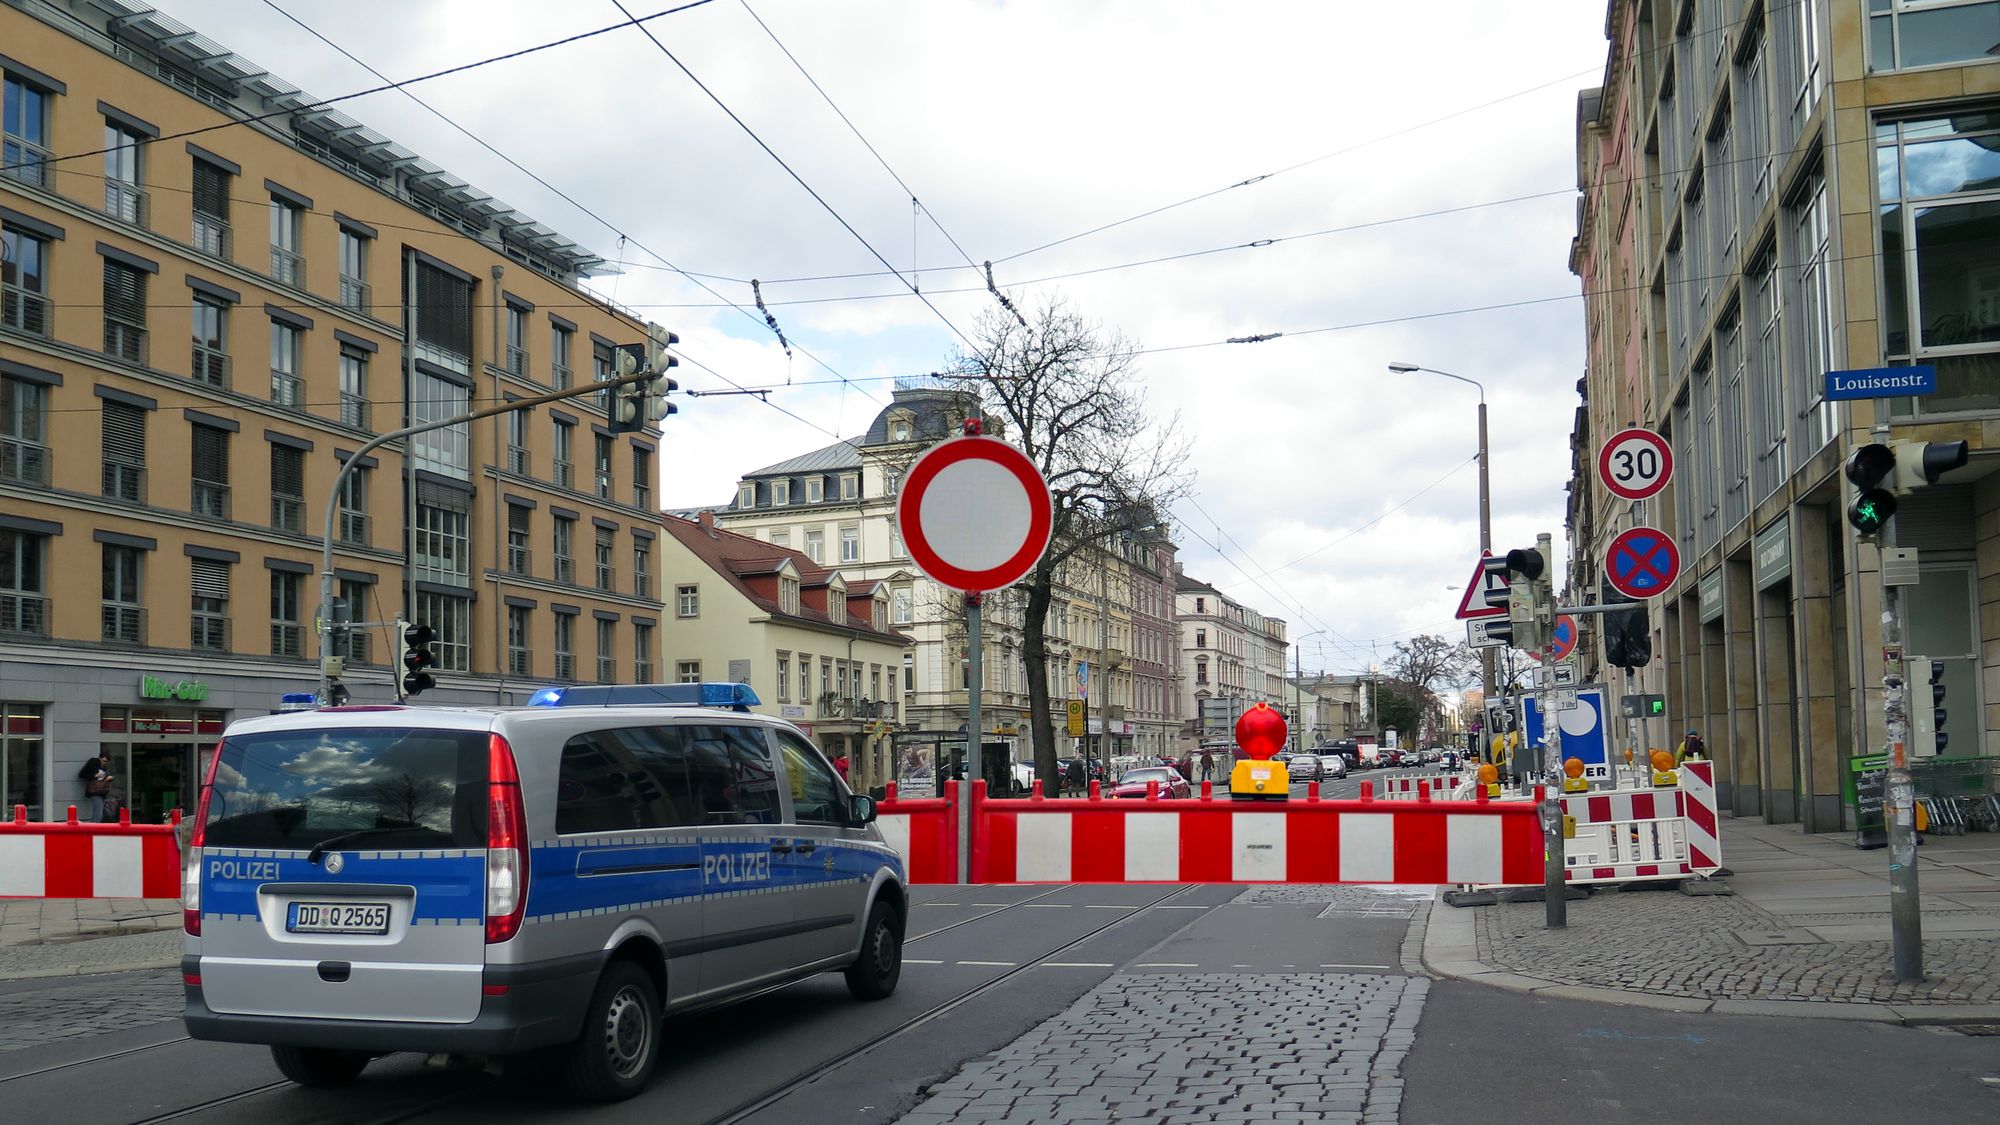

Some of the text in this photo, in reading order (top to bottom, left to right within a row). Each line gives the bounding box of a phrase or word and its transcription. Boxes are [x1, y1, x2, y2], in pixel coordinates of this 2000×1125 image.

[1834, 375, 1928, 391] Louisenstr.
[1614, 448, 1657, 481] 30
[210, 860, 280, 880] POLIZEI
[704, 852, 771, 885] POLIZEI
[298, 907, 386, 927] DD Q 2565
